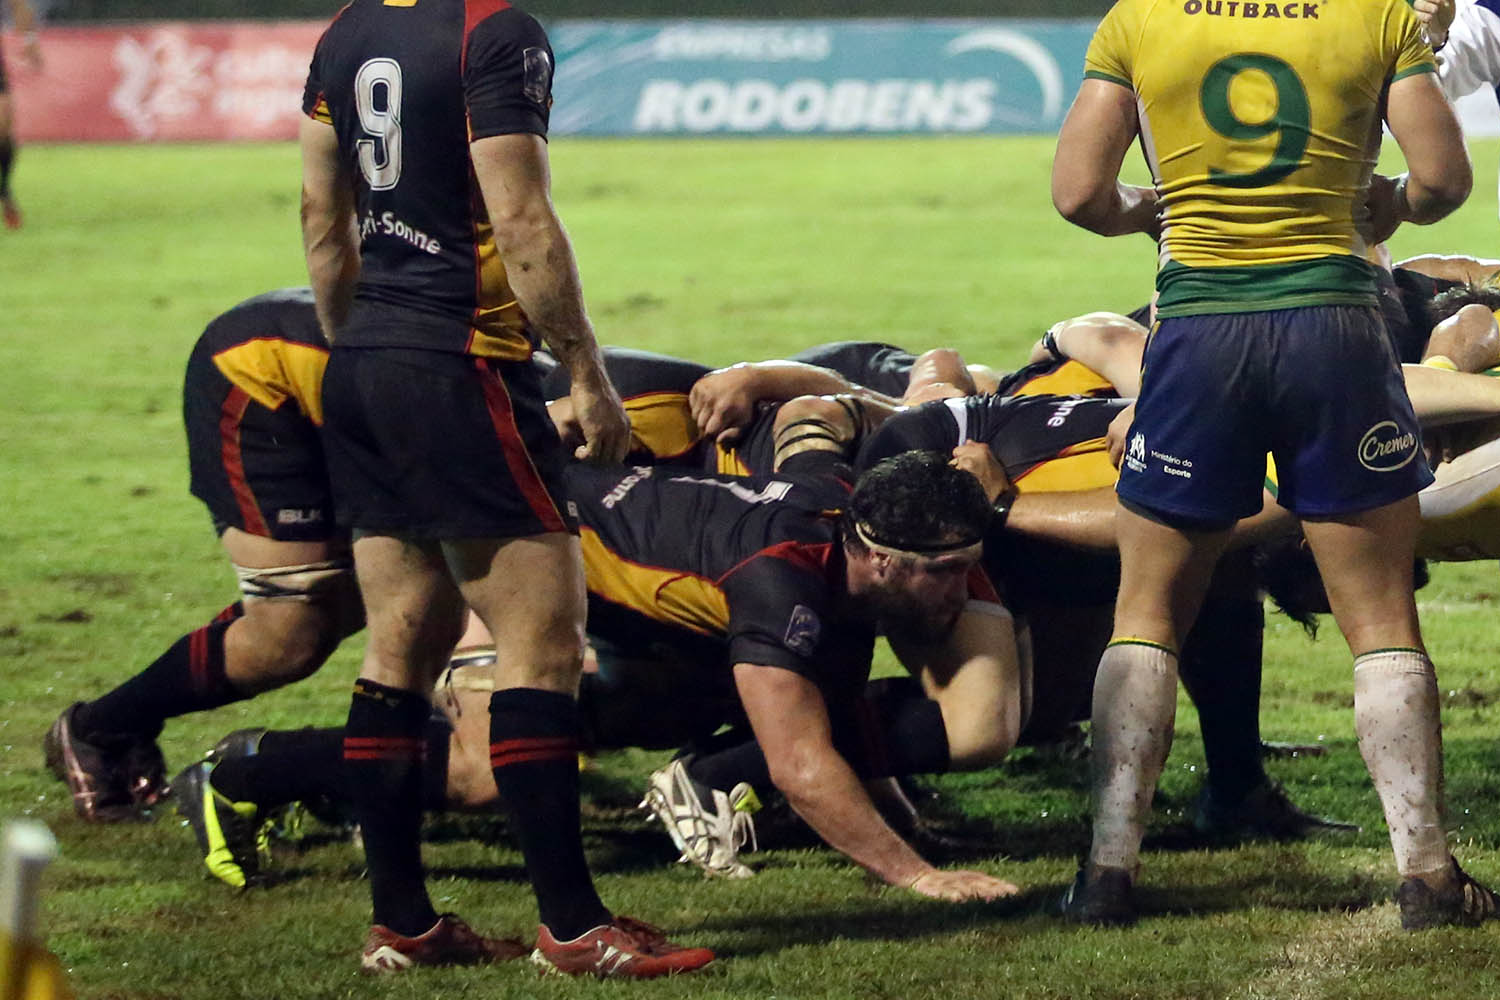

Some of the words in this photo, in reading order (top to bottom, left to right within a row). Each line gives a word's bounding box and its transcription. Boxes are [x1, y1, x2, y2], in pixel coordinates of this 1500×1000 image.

[1183, 0, 1319, 19] OUTBACK
[633, 79, 998, 132] RODOBENS
[1199, 51, 1312, 189] 9
[355, 57, 403, 191] 9
[1362, 432, 1415, 461] Cremer
[1163, 466, 1192, 479] Esporte
[1181, 458, 1193, 468] do
